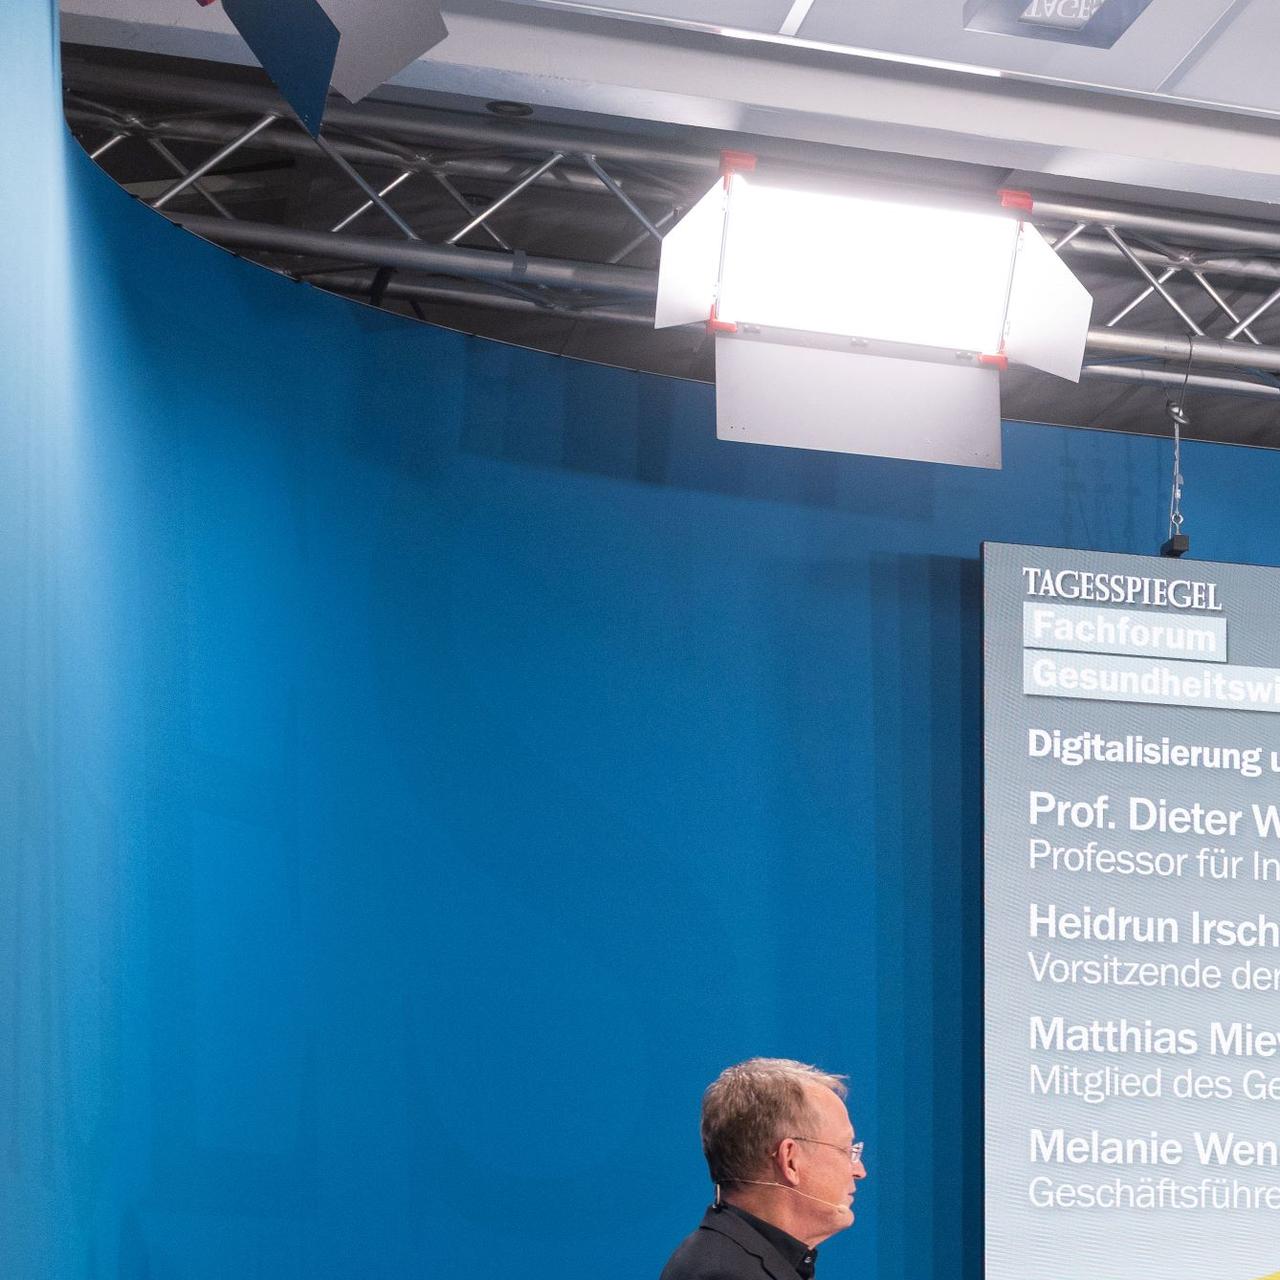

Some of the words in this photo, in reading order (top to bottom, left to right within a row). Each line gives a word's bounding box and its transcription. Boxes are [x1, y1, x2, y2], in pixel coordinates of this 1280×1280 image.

[1021, 566, 1223, 611] TAGESSPIEGEL
[1033, 610, 1217, 652] Fachforum
[1026, 728, 1264, 780] Digitalisierung
[1027, 791, 1118, 832] Prof.
[1128, 796, 1242, 837] Dieter
[1027, 838, 1188, 878] Professor
[1196, 846, 1240, 881] für
[1027, 903, 1180, 945] Heidrun
[1027, 952, 1223, 989] Vorsitzende
[1027, 1017, 1199, 1056] Matthias
[1027, 1064, 1164, 1104] Mitglied
[1172, 1067, 1234, 1100] des
[1027, 1129, 1183, 1166] Melanie
